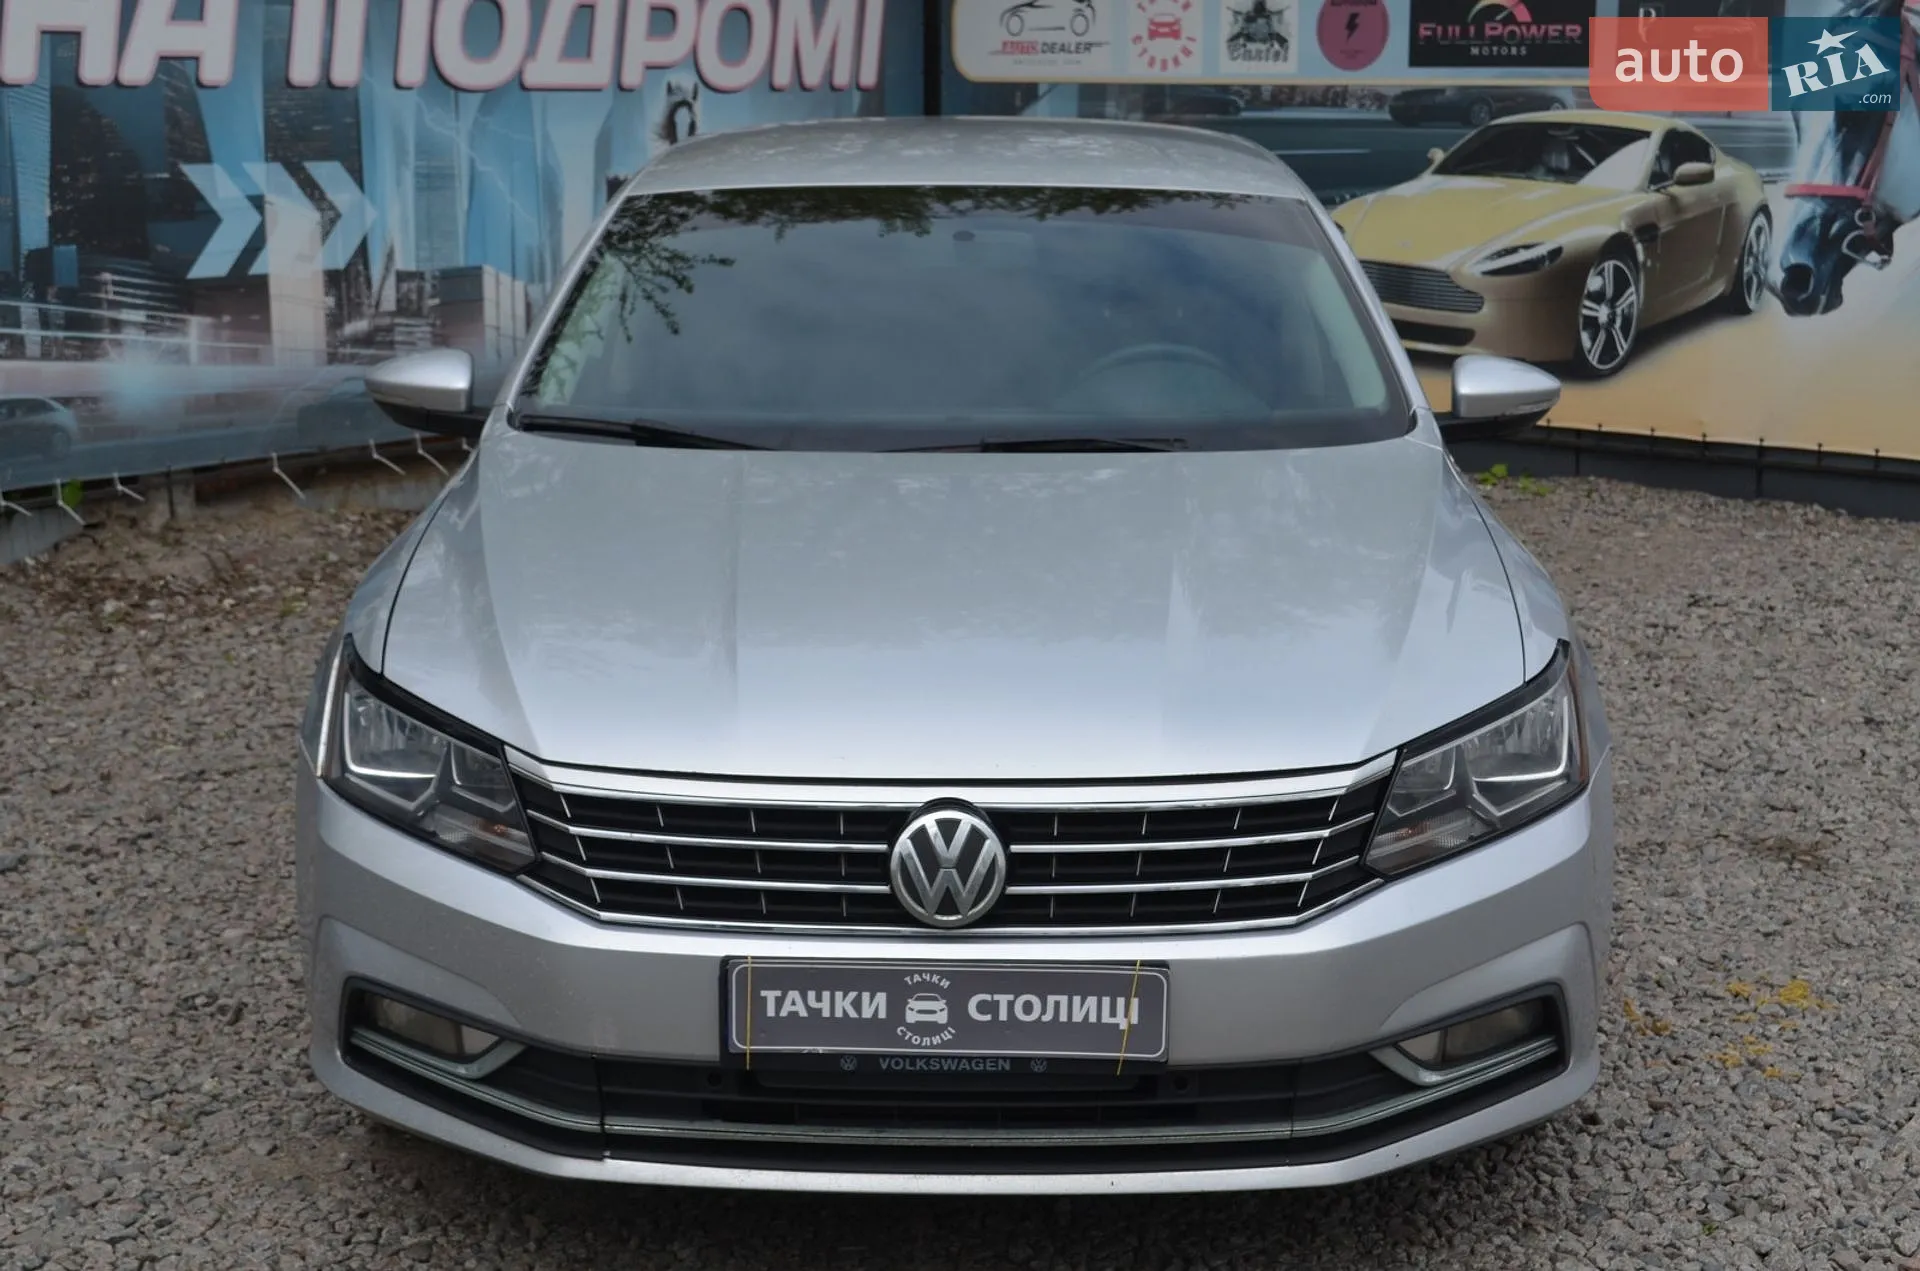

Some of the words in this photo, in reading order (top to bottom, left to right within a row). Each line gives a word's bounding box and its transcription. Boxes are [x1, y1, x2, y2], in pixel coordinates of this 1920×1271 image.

[1, 0, 238, 87] НА
[1041, 41, 1092, 54] DEALER
[1469, 46, 1528, 56] MOTORS
[904, 972, 951, 989] ТАЧКИ
[760, 990, 888, 1019] ТАЧКИ
[967, 993, 1140, 1030] СТОЛИЦІ
[896, 1026, 956, 1046] СТОЛИЦІ
[879, 1056, 1011, 1071] VOLKSWAGEN
